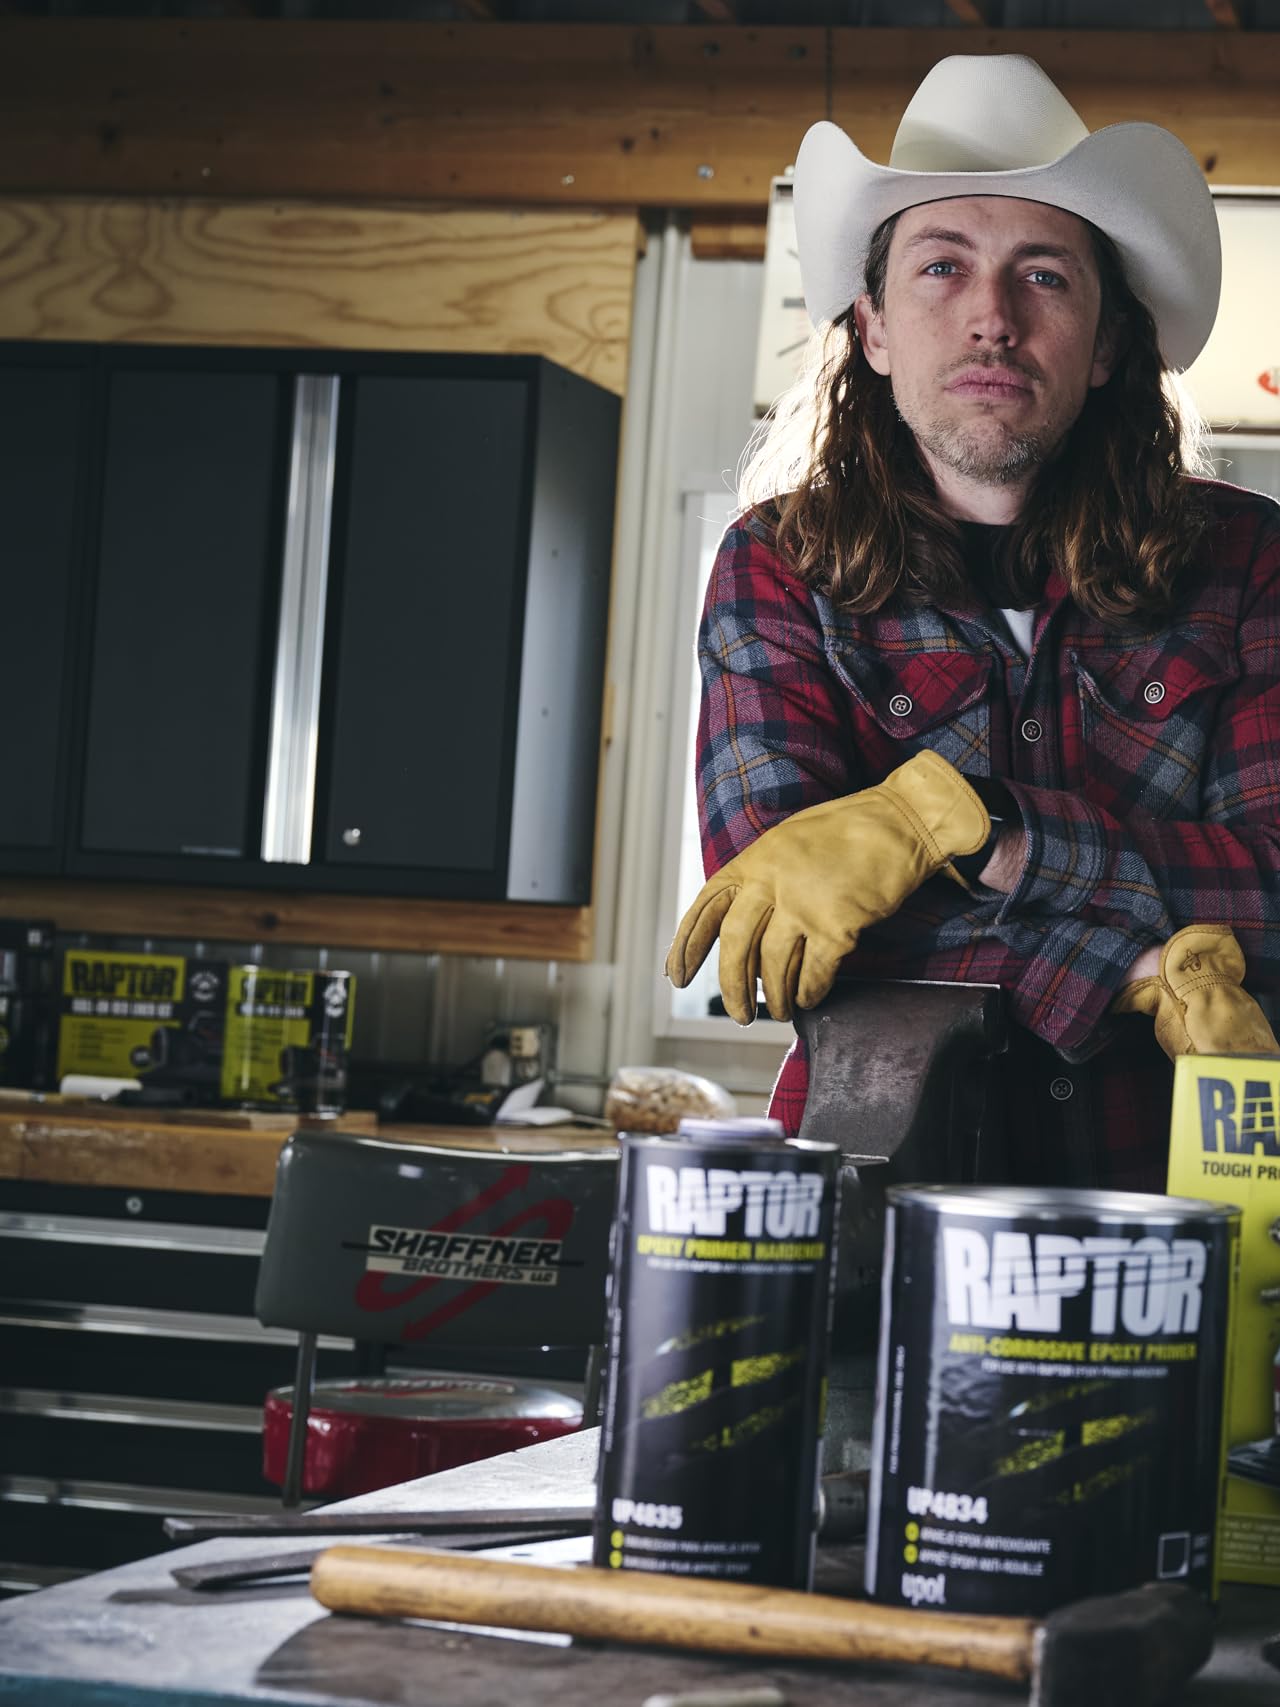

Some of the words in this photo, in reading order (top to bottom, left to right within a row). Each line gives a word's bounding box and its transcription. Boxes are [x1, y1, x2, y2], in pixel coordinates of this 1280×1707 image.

[71, 959, 177, 999] RAPTOR
[1202, 1161, 1252, 1178] TOUGH
[646, 1164, 825, 1239] RAPTOR
[373, 1228, 561, 1266] SHAFFNER
[402, 1258, 524, 1281] BROTHERS
[943, 1227, 1207, 1336] RAPTOR
[950, 1333, 1085, 1360] ANTI-CORROSIVE
[1089, 1342, 1143, 1361] EPOXY
[1145, 1343, 1198, 1361] PRIMER
[907, 1486, 989, 1524] UP4834
